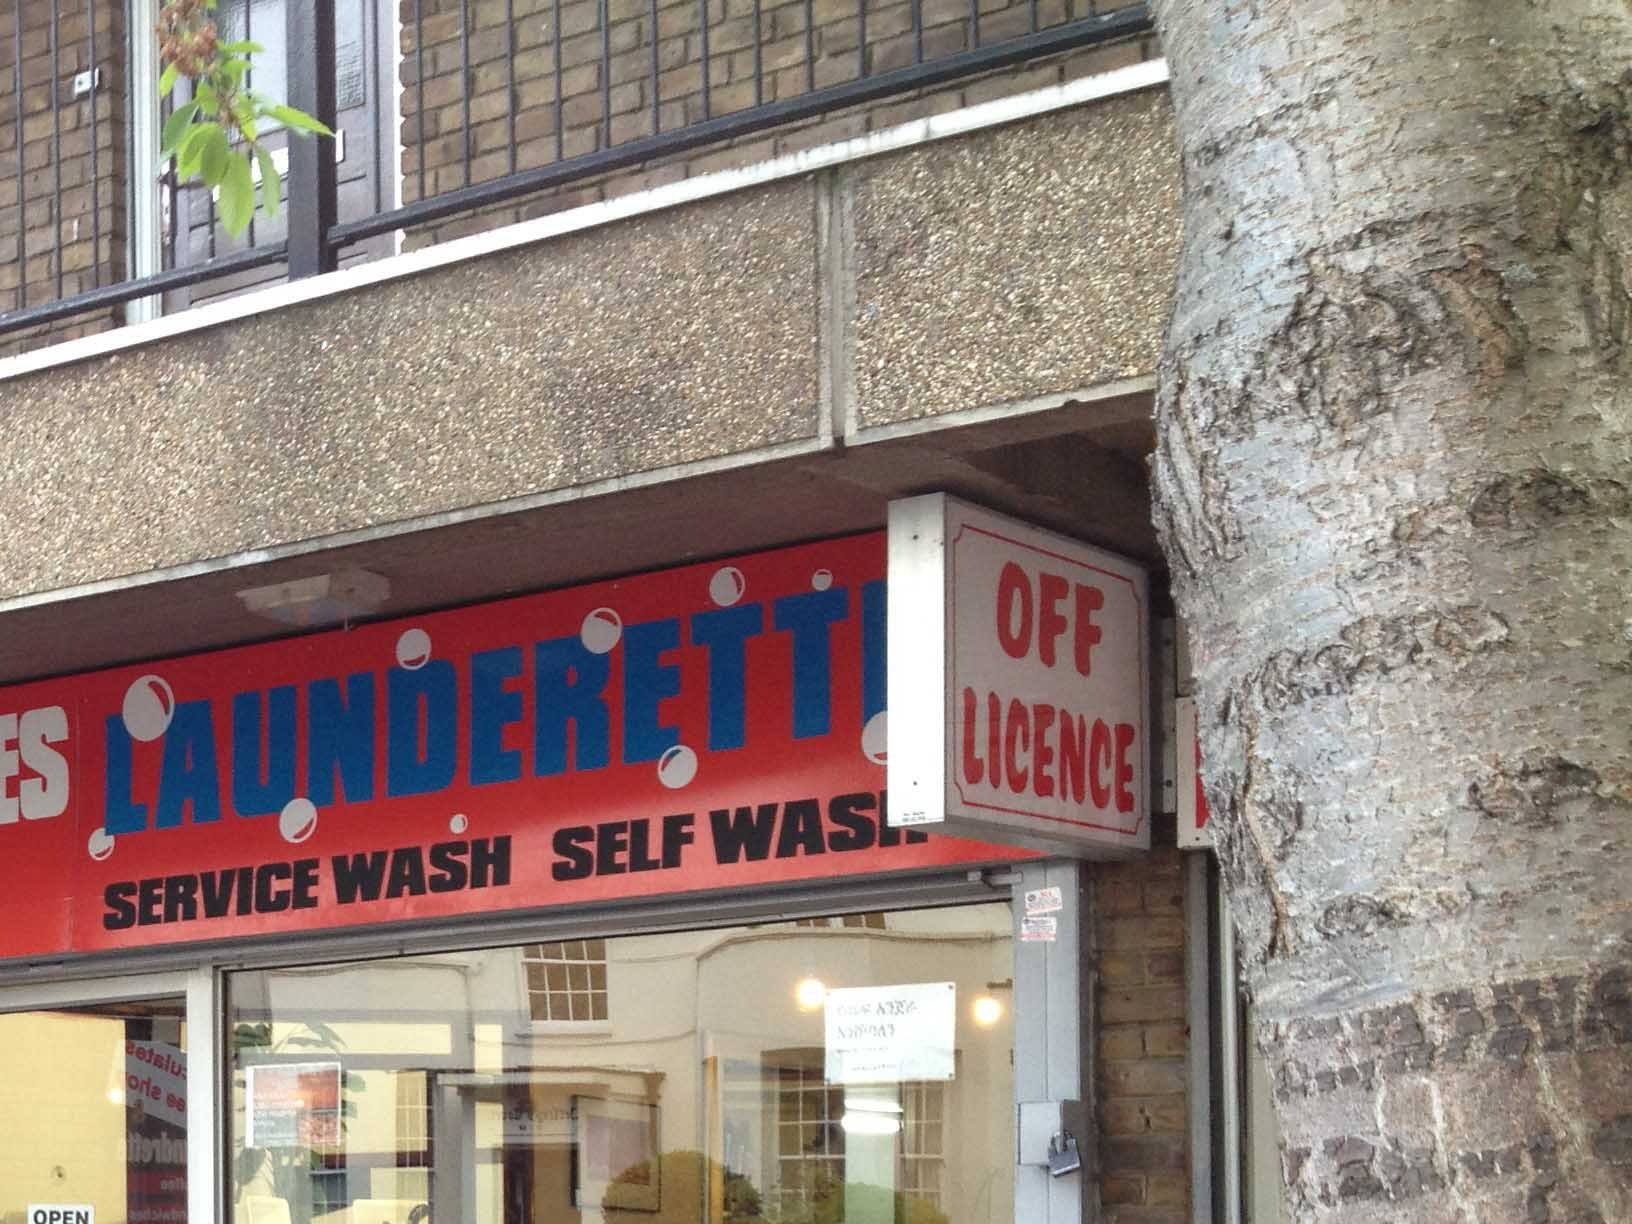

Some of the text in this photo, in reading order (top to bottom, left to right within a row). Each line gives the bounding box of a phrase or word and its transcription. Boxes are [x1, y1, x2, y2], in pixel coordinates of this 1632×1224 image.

[996, 560, 1104, 677] OFF
[963, 686, 1135, 813] LICENCE
[103, 857, 319, 931] SERVICE
[331, 835, 512, 905] WASH
[552, 813, 695, 882] SELF
